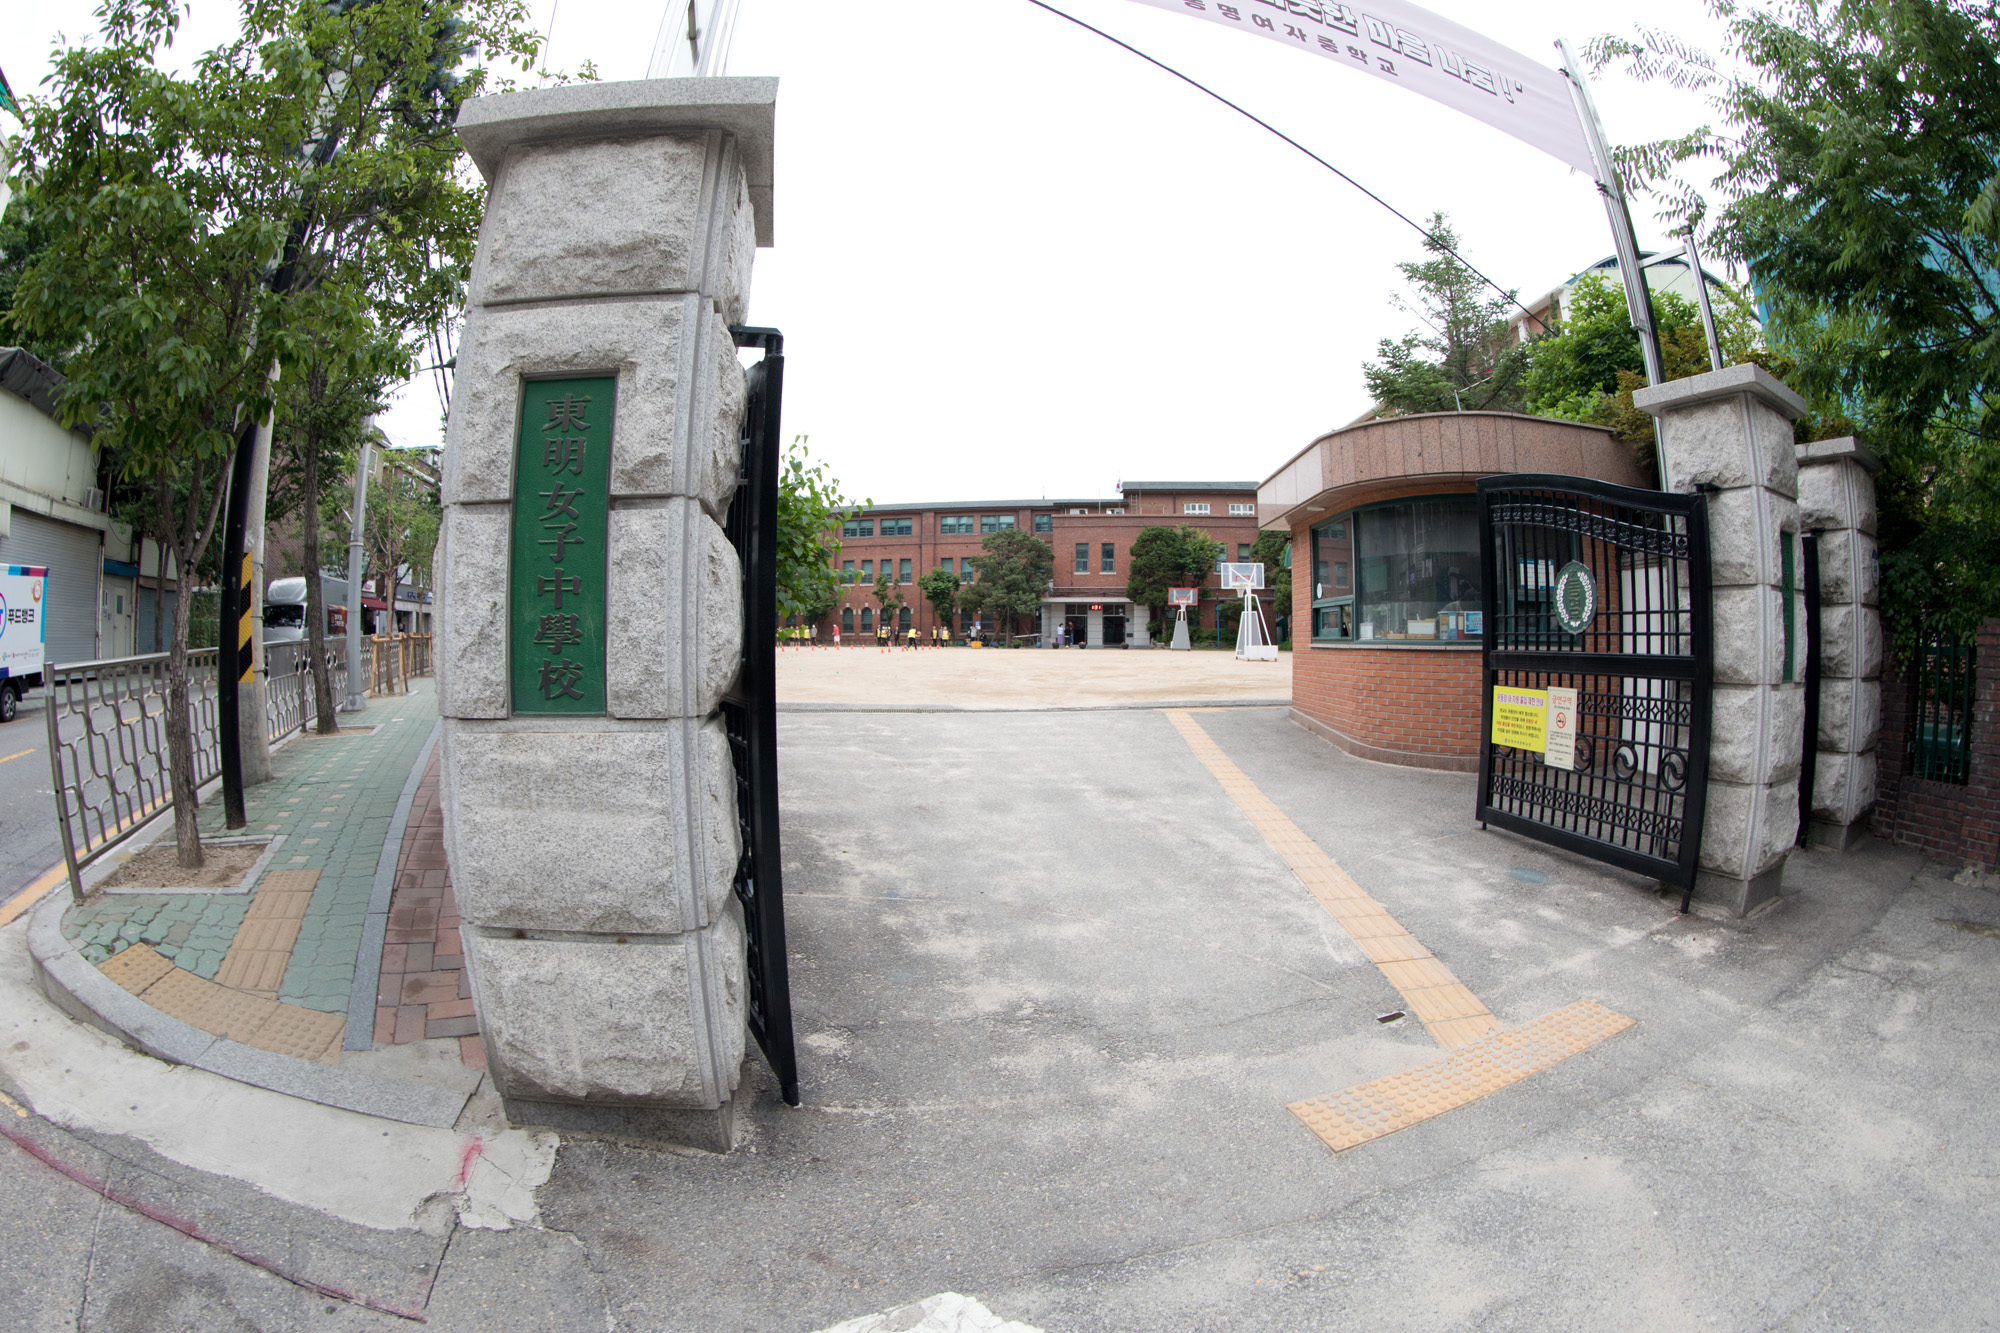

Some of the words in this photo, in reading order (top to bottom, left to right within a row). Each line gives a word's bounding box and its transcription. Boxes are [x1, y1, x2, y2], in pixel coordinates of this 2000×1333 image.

[1362, 13, 1432, 67] 마음
[534, 393, 591, 700] 東明女子中學校
[8, 608, 34, 625] 푸드뱅크
[1552, 695, 1572, 706] 금연구역
